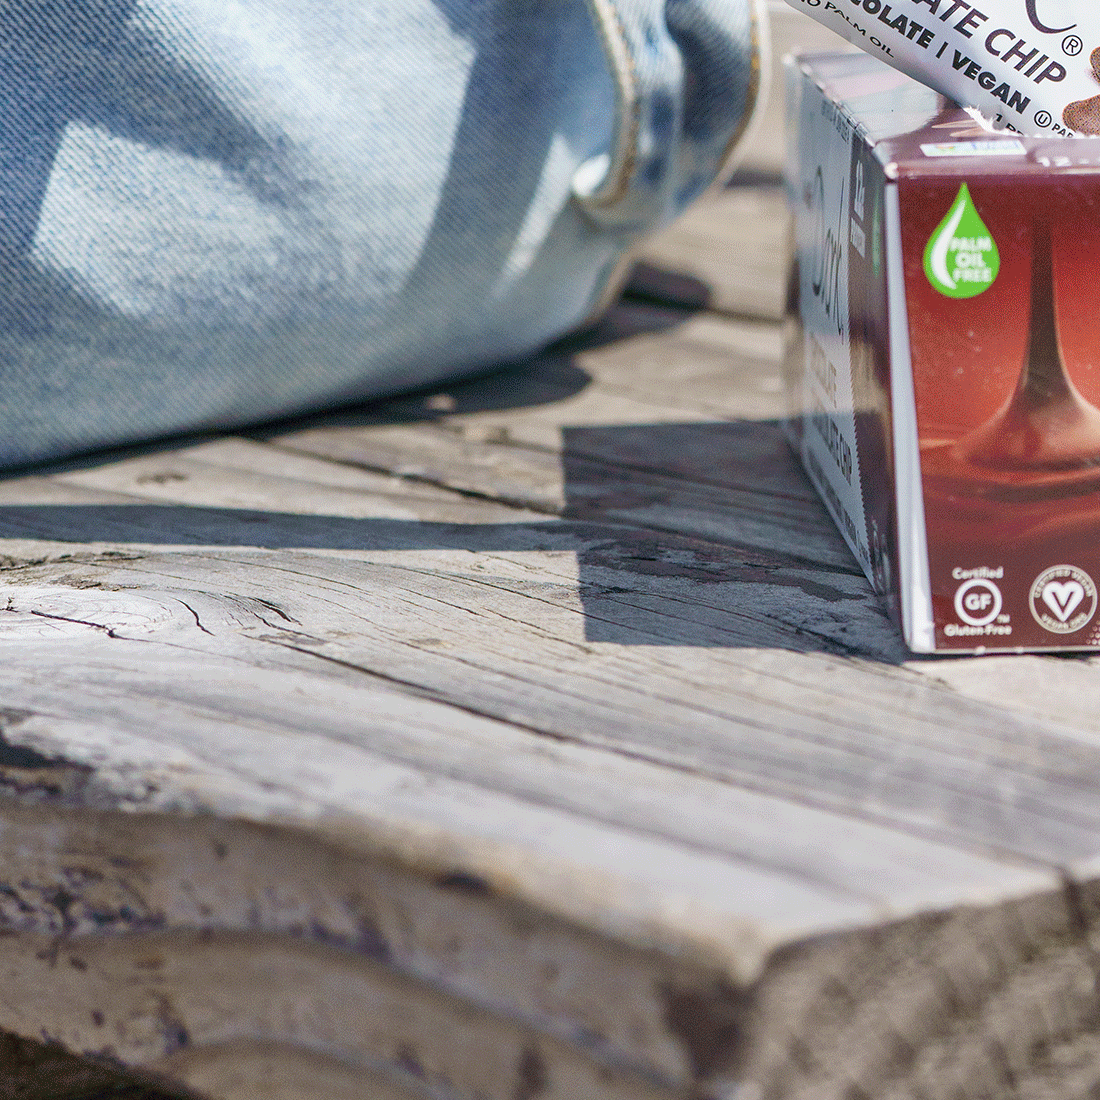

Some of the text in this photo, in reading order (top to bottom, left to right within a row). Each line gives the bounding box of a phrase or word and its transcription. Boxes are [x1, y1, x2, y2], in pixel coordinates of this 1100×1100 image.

[824, 1, 868, 36] PALM
[869, 35, 895, 59] OIL
[984, 28, 1067, 84] CHIP
[951, 48, 1031, 115] VEGAN
[952, 566, 1004, 580] Certified
[965, 593, 992, 610] GF
[944, 624, 1012, 637] Gluten-Free
